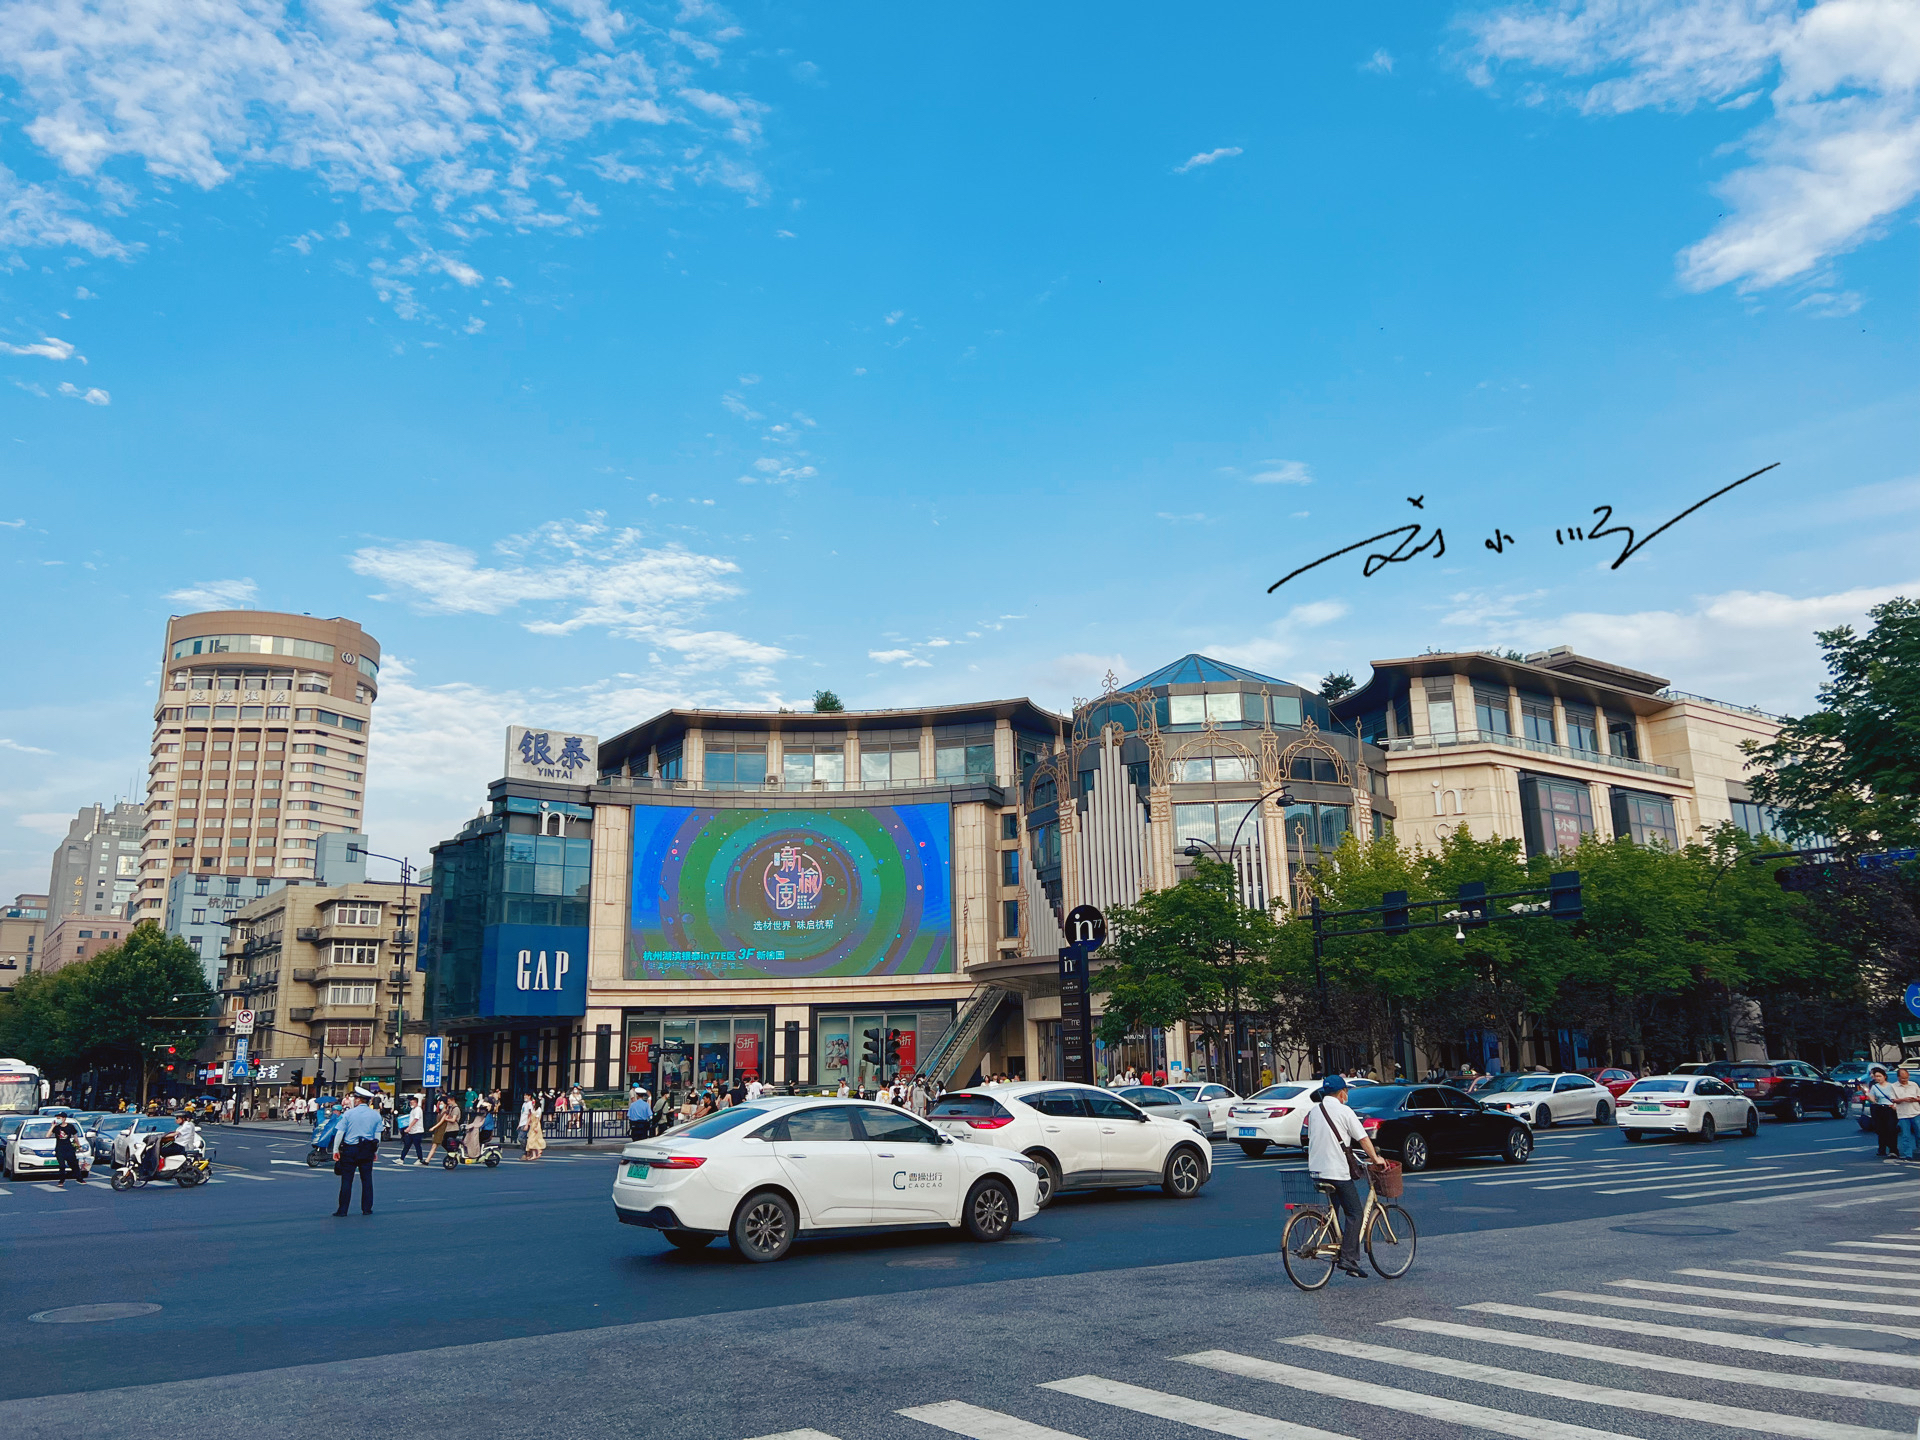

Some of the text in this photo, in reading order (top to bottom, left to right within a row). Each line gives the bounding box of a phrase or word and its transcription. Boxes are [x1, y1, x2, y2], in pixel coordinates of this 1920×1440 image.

[518, 730, 591, 770] 银泰
[537, 767, 573, 780] YINTAI
[752, 920, 792, 931] 选材世界
[737, 947, 756, 961] 3F
[516, 949, 570, 991] GAP
[629, 1041, 649, 1053] 5折
[736, 1037, 754, 1049] 5折
[426, 1052, 437, 1083] 平海路
